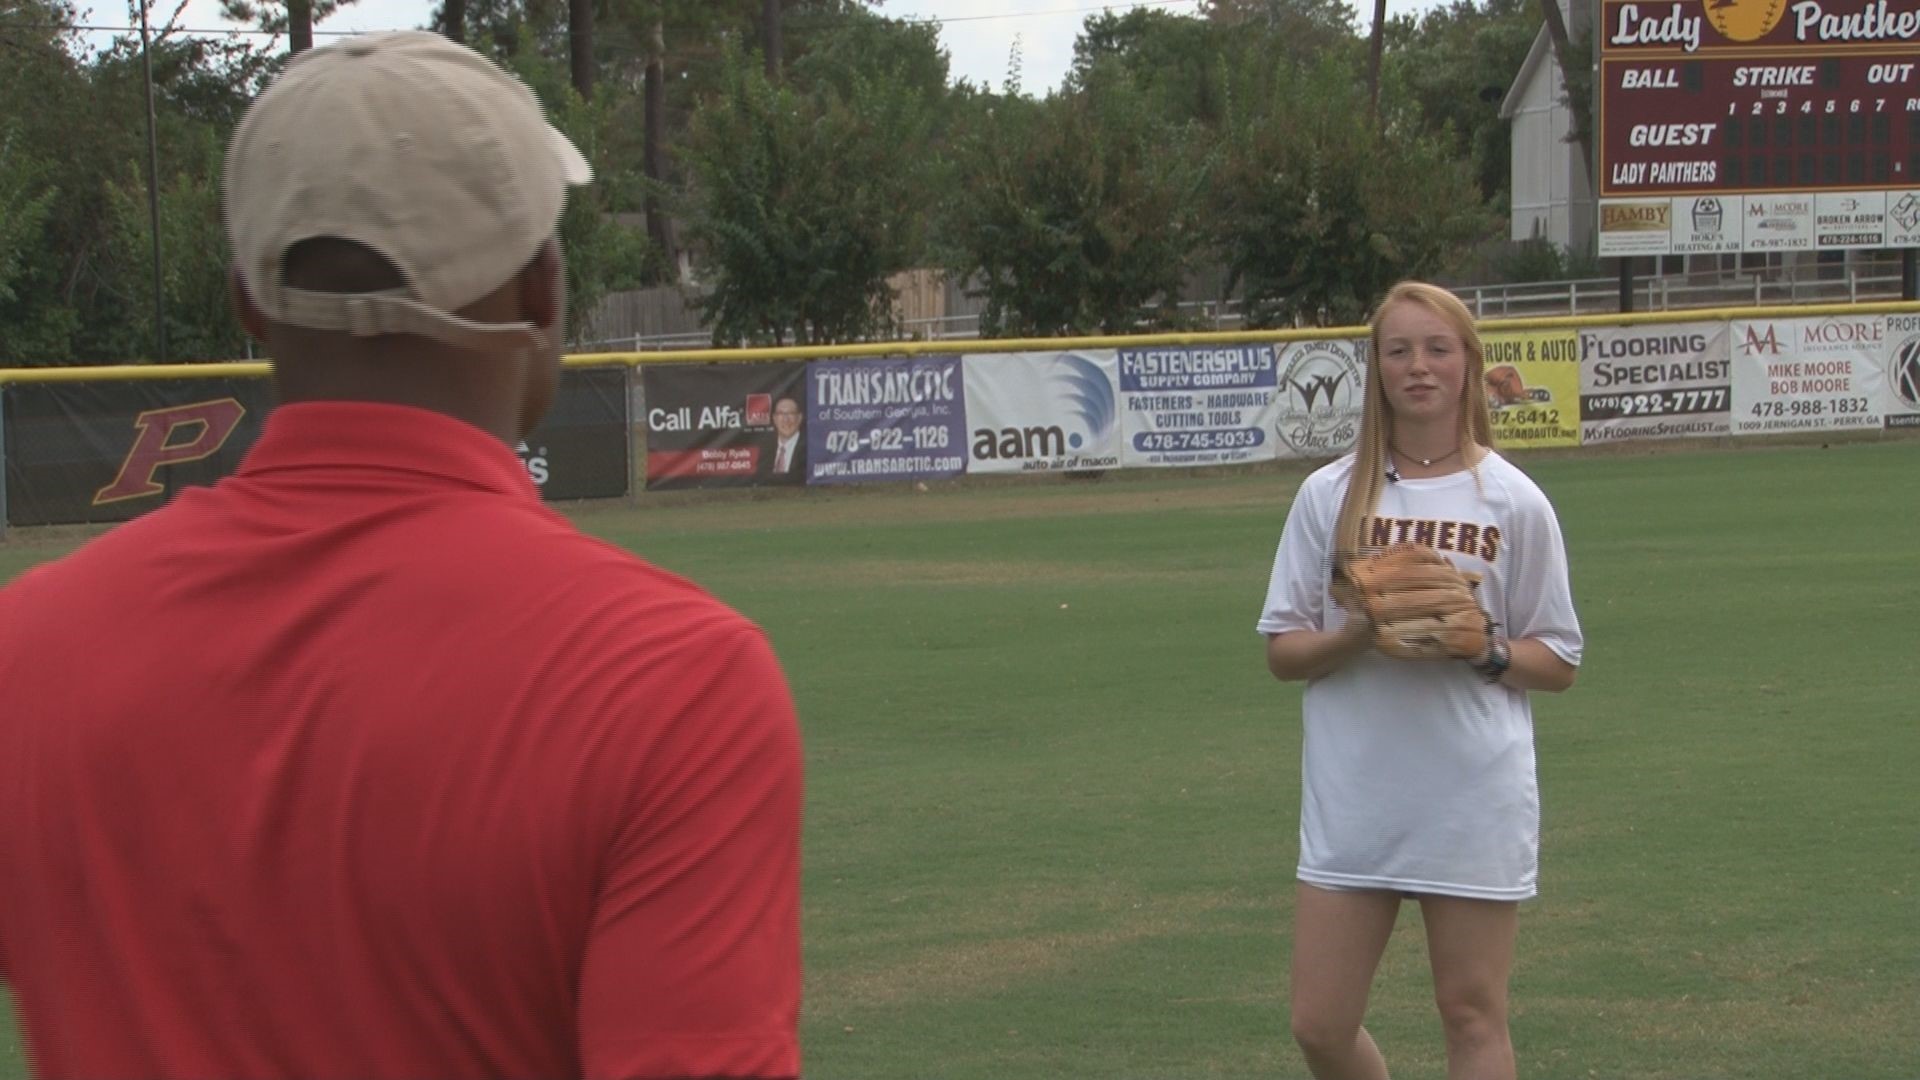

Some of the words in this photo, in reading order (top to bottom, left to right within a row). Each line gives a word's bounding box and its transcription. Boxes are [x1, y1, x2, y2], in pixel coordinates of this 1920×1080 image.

[1611, 3, 1700, 52] Lady
[1621, 68, 1680, 89] BALL
[1733, 66, 1816, 87] STRIKE
[1867, 63, 1915, 84] OUT
[1728, 102, 1736, 115] 1
[1752, 102, 1763, 115] 2
[1776, 102, 1787, 114] 3
[1801, 100, 1811, 113] 4
[1825, 100, 1835, 113] 5
[1850, 99, 1860, 112] 6
[1875, 99, 1885, 111] 7
[1629, 123, 1717, 146] GUEST
[1612, 163, 1647, 185] LADY
[1650, 161, 1717, 184] PANTHERS
[1602, 206, 1669, 225] HAMBY
[1817, 215, 1850, 225] BROKEN
[1854, 214, 1884, 223] ARROW
[1804, 322, 1884, 343] MOORE
[1485, 342, 1522, 362] RUCK
[1527, 341, 1537, 362] &
[1541, 339, 1577, 361] AUTO
[1580, 334, 1706, 361] FLOORING
[1122, 348, 1272, 374] FASTENERSPLUS
[1768, 363, 1801, 378] MIKE
[1804, 361, 1852, 377] MOORE
[1139, 374, 1189, 388] SUPPLY
[1193, 372, 1256, 386] COMPANY
[1593, 361, 1730, 387] SPECIALIST
[815, 367, 955, 406] TRANSARCTIC
[1770, 380, 1799, 395] BOB
[1802, 378, 1850, 393] MOORE
[1128, 396, 1193, 411] FASTENERS
[1207, 392, 1269, 408] HARDWARE
[1752, 397, 1869, 417] 478-988-1832
[649, 407, 691, 431] Call
[698, 405, 741, 430] Alfa
[819, 408, 831, 420] of
[833, 407, 882, 421] Southern
[1156, 412, 1205, 428] CUTTING
[1208, 411, 1242, 426] TOOLS
[1490, 409, 1559, 425] 87-6412
[1738, 422, 1761, 431] 1009
[1763, 420, 1812, 430] JERNIGAN
[1867, 416, 1880, 425] GA
[1142, 430, 1256, 449] 478-745-5033
[1333, 422, 1354, 446] 1985
[92, 397, 246, 505] P
[813, 456, 962, 477] www.TRANSARCTIC.com
[1022, 460, 1049, 470] auto
[1051, 457, 1065, 469] air
[1066, 456, 1079, 468] of
[1081, 456, 1118, 467] macon
[1361, 516, 1501, 562] NTHERS
